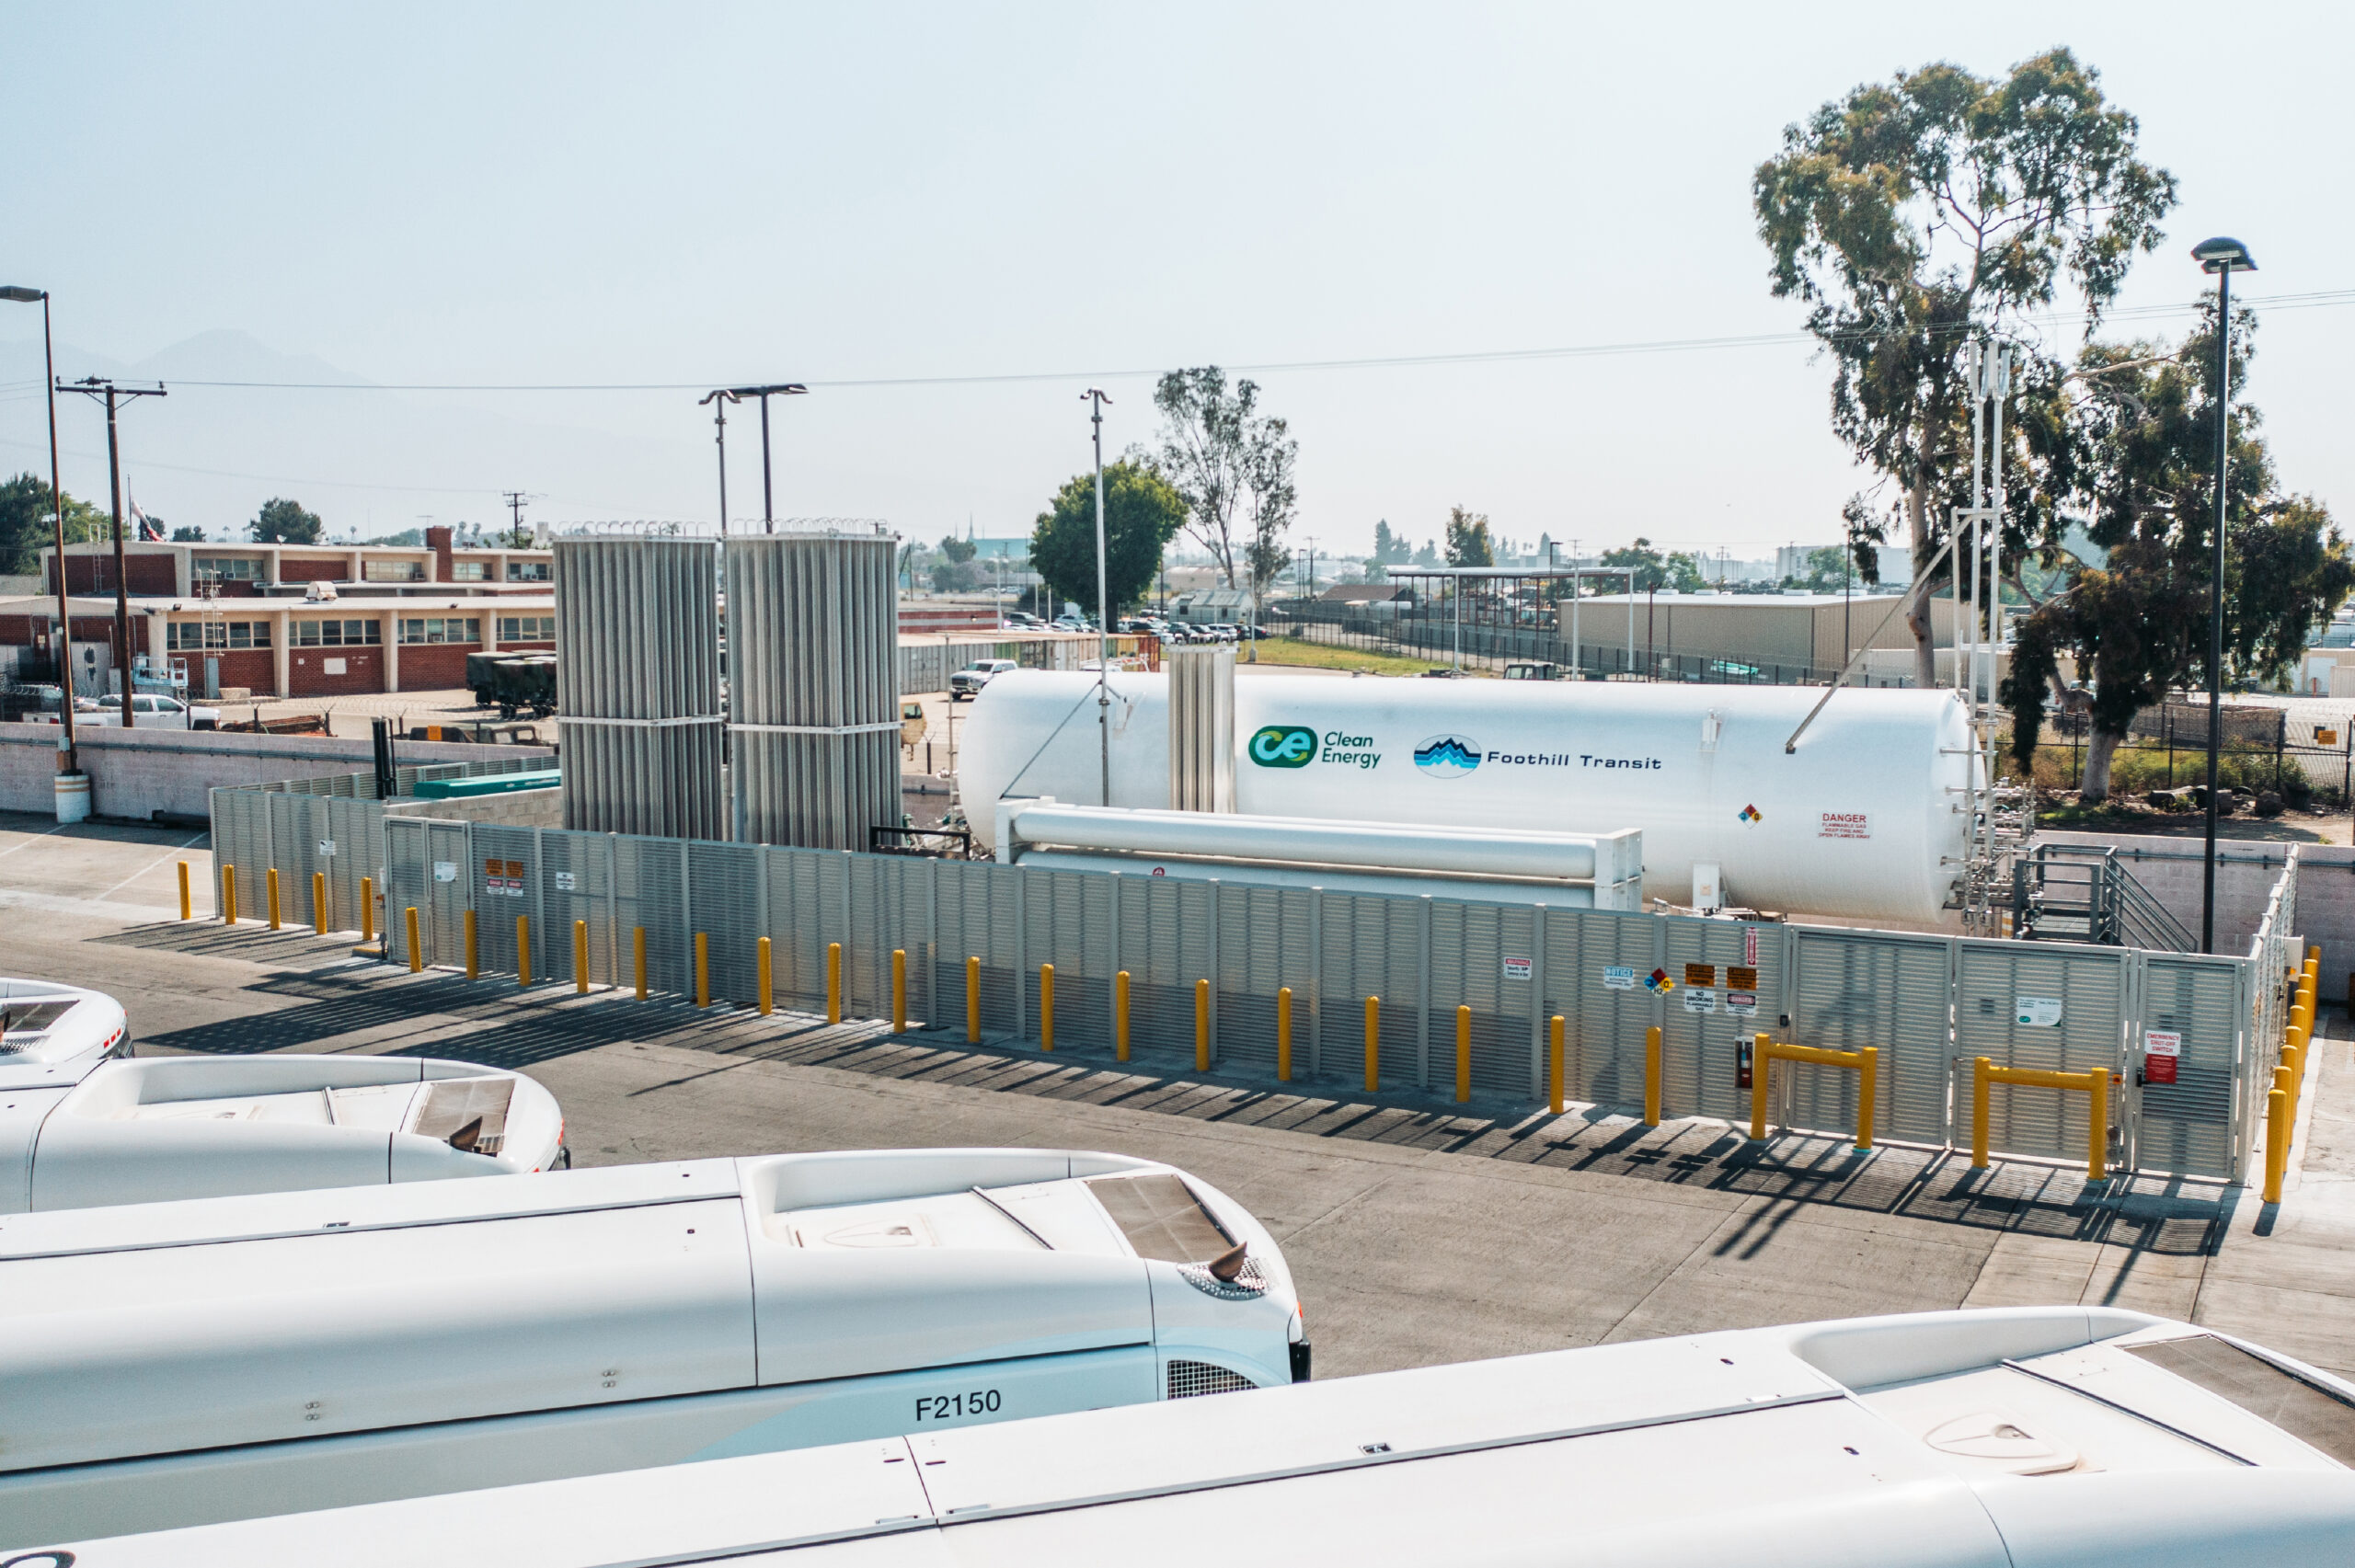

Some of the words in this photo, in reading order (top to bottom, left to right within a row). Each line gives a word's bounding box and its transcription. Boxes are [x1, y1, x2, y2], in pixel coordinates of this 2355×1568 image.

[1325, 731, 1373, 747] Clean
[1322, 748, 1382, 769] Energy
[1488, 751, 1569, 766] Foothill
[1580, 755, 1662, 770] Transit
[1822, 813, 1867, 823] DANGER
[1605, 967, 1632, 977] NOTICE
[1663, 980, 1670, 989] 0
[916, 1389, 1001, 1421] F2150
